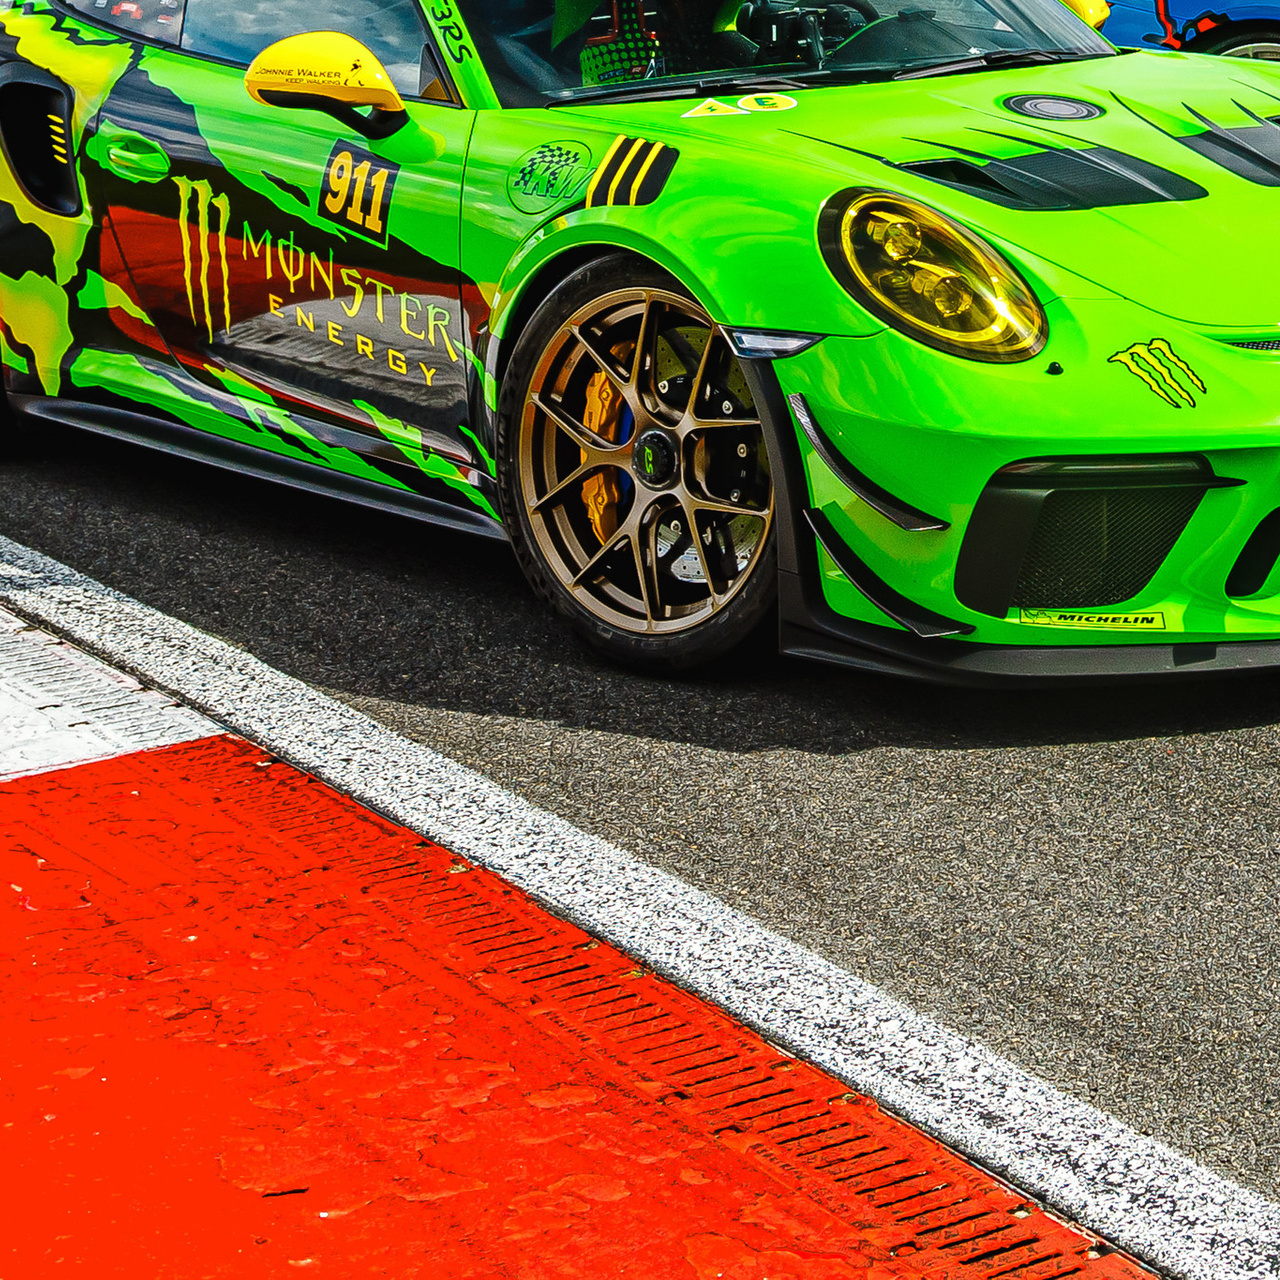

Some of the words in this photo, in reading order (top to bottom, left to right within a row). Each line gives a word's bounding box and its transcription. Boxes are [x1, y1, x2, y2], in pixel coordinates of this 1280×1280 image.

[255, 66, 294, 77] JOHNNIE
[297, 68, 342, 79] WALKER
[306, 78, 341, 86] WALKING
[523, 162, 597, 198] KW
[324, 151, 389, 234] 911
[268, 293, 437, 386] ENERGY
[1057, 613, 1156, 625] MICHELIN
